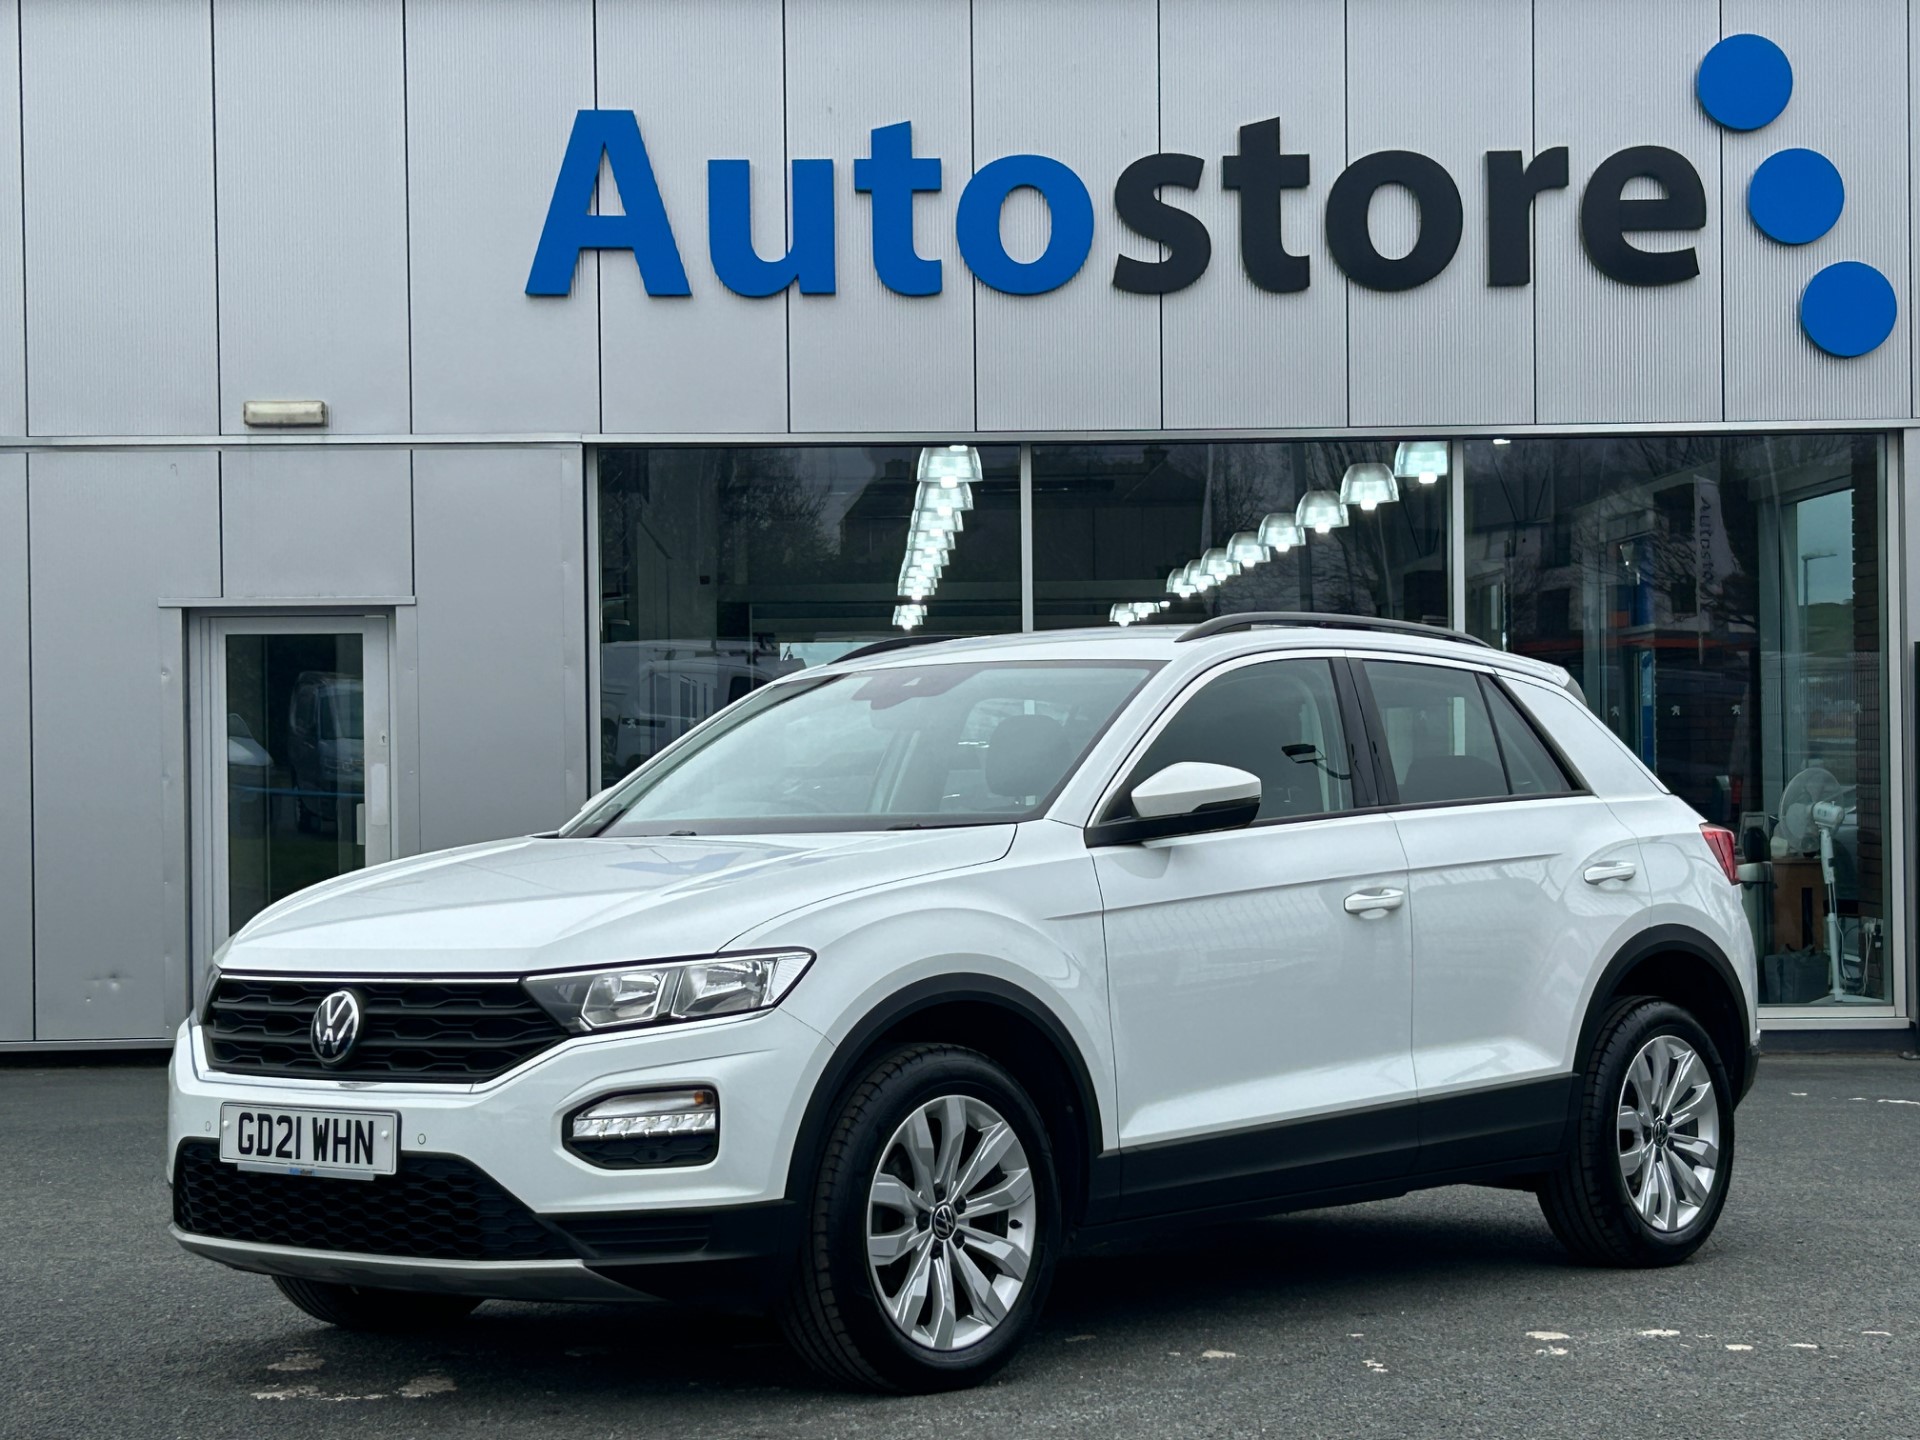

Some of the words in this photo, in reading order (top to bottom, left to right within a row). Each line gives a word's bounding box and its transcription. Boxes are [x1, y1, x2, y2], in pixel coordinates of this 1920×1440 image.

[525, 109, 1707, 298] Autostore
[1699, 495, 1715, 585] Autosto
[237, 1112, 302, 1160] GD21
[312, 1117, 374, 1165] WHN
